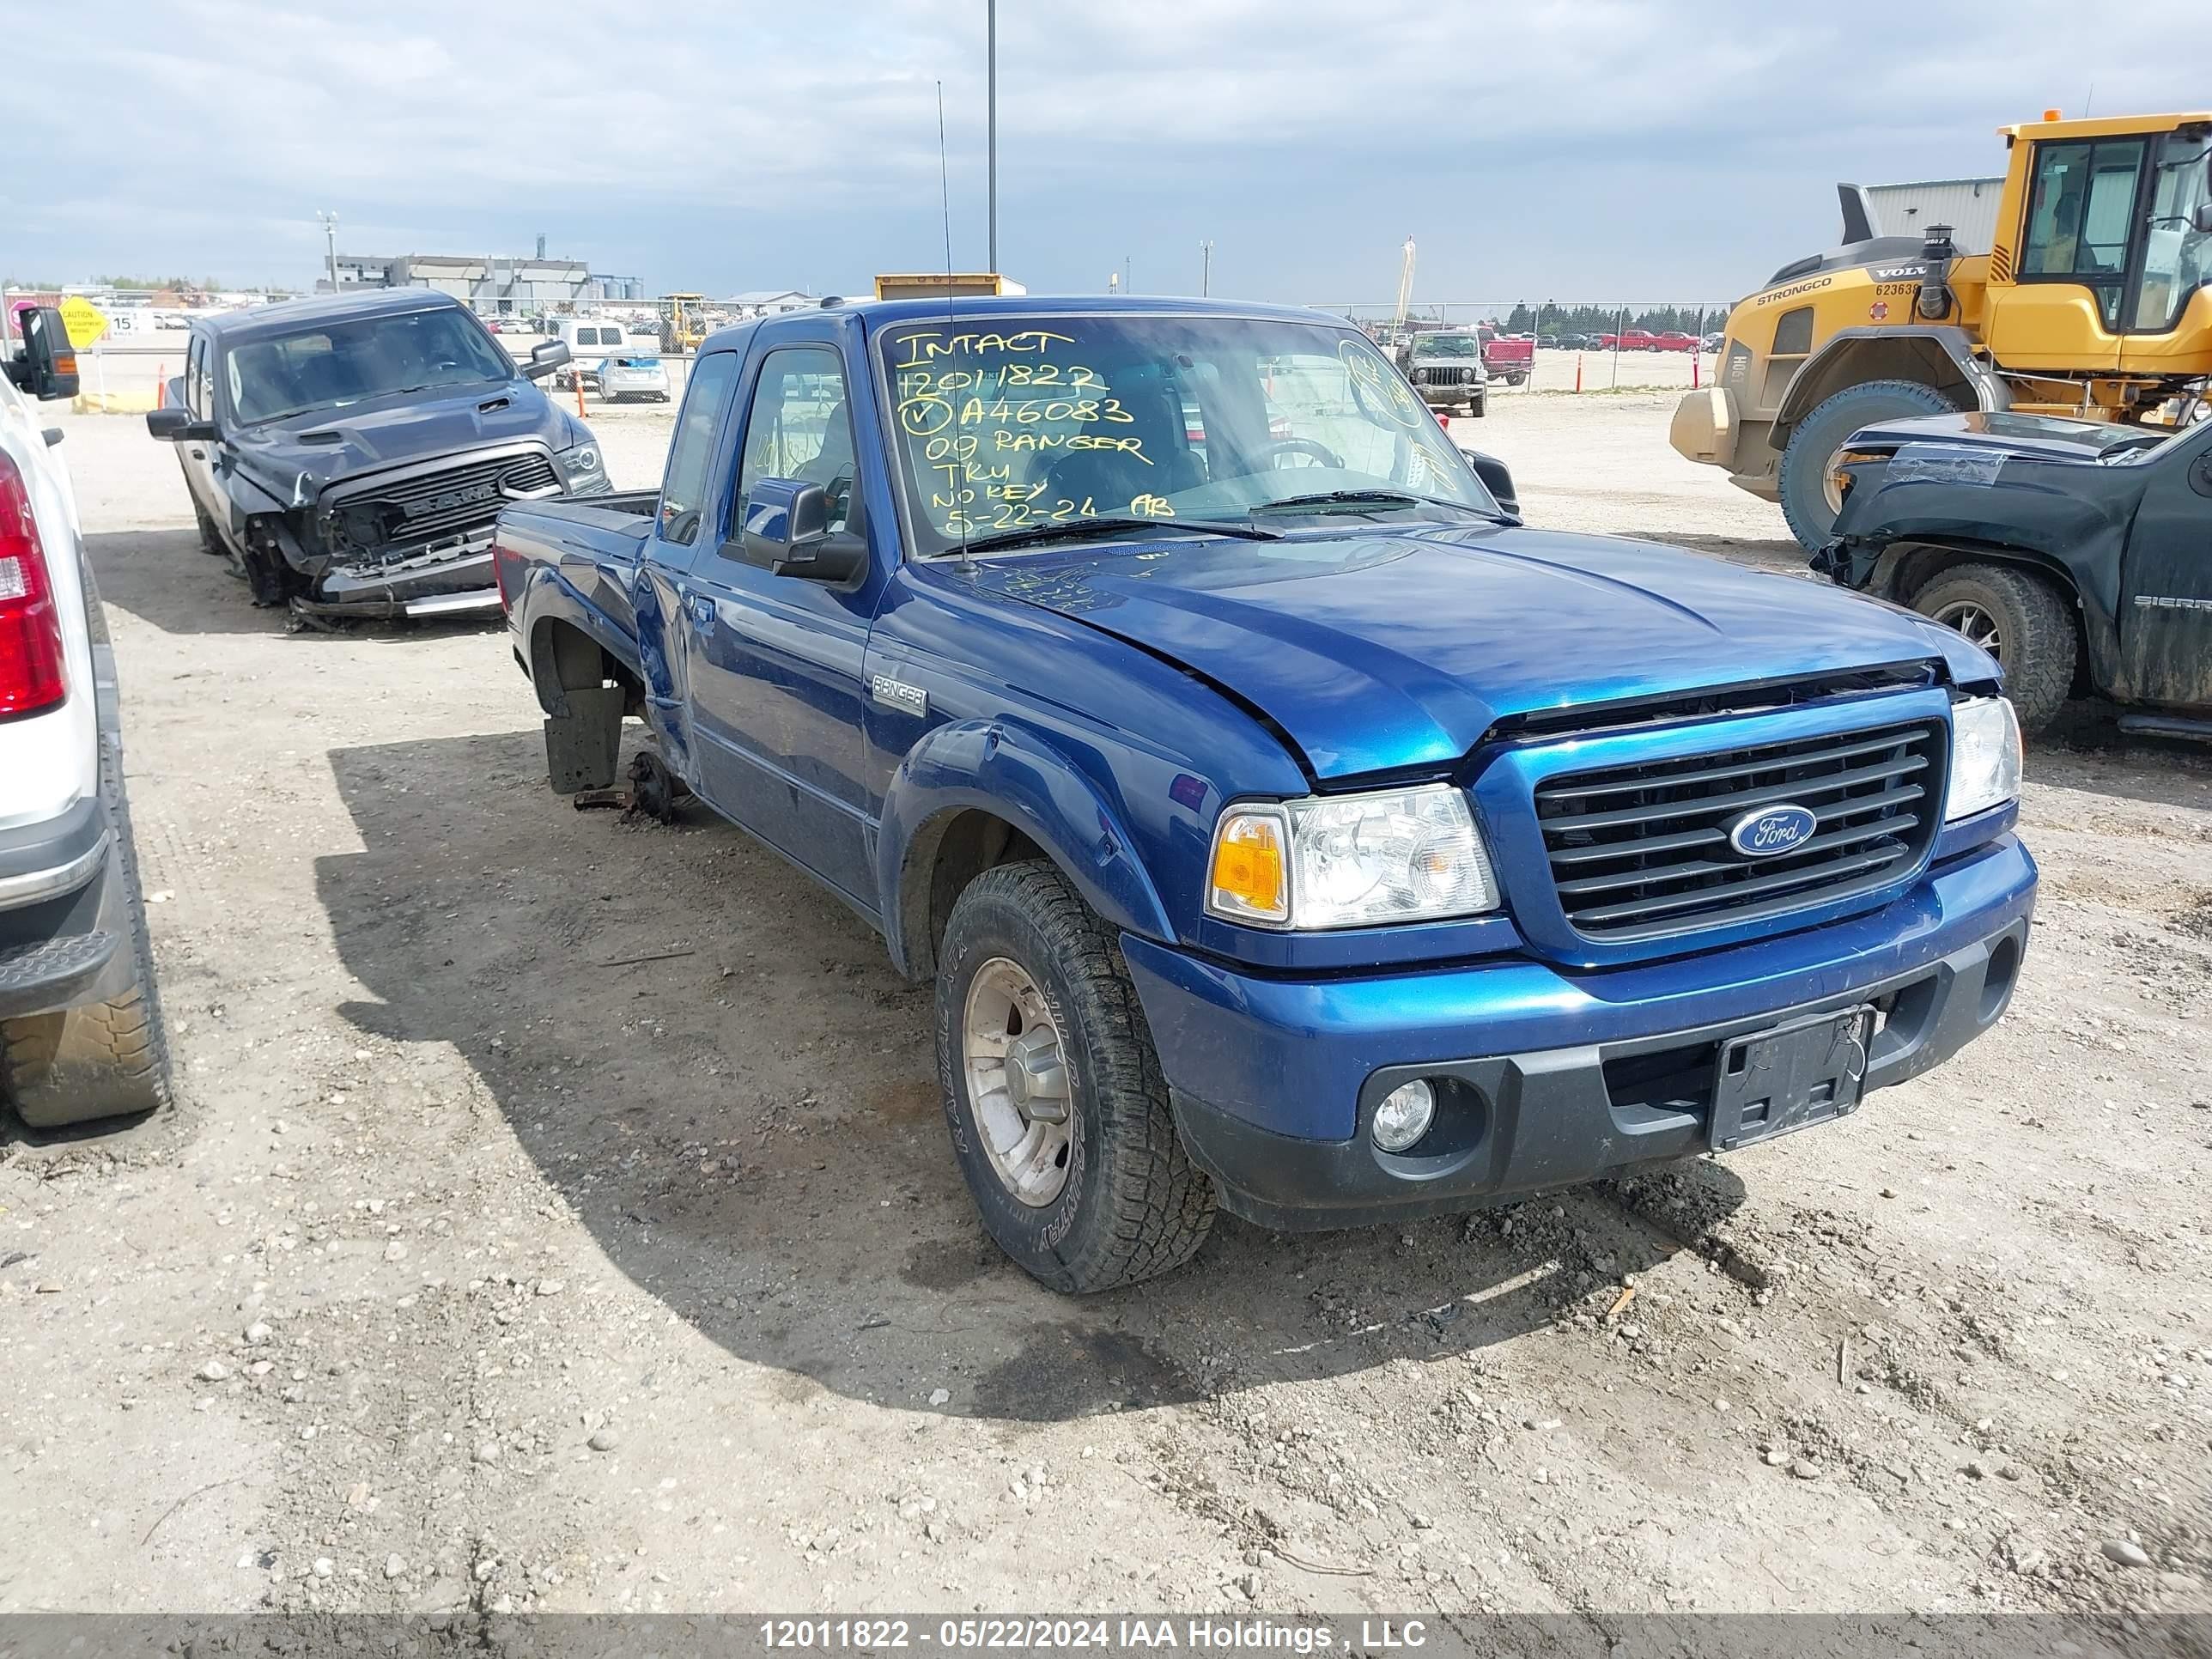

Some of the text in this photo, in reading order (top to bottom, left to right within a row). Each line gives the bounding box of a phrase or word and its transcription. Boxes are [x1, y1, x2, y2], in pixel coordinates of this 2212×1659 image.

[1876, 267, 1927, 277] VOLV
[1757, 277, 1832, 306] STRONGCO
[113, 317, 131, 330] 15
[896, 331, 1075, 368] INTACT
[900, 364, 1110, 398] 12011822
[960, 397, 1134, 425] A46083
[994, 430, 1155, 465] RANGER
[400, 483, 497, 518] RAM
[933, 477, 1048, 508] NO KEY
[945, 496, 1098, 534] 5-22-24
[2134, 596, 2212, 610] SIERR
[873, 678, 924, 707] RANGER
[1754, 816, 1800, 847] Ford
[938, 1009, 969, 1153] RADIAL
[1038, 978, 1085, 1252] WILD COUNTRY
